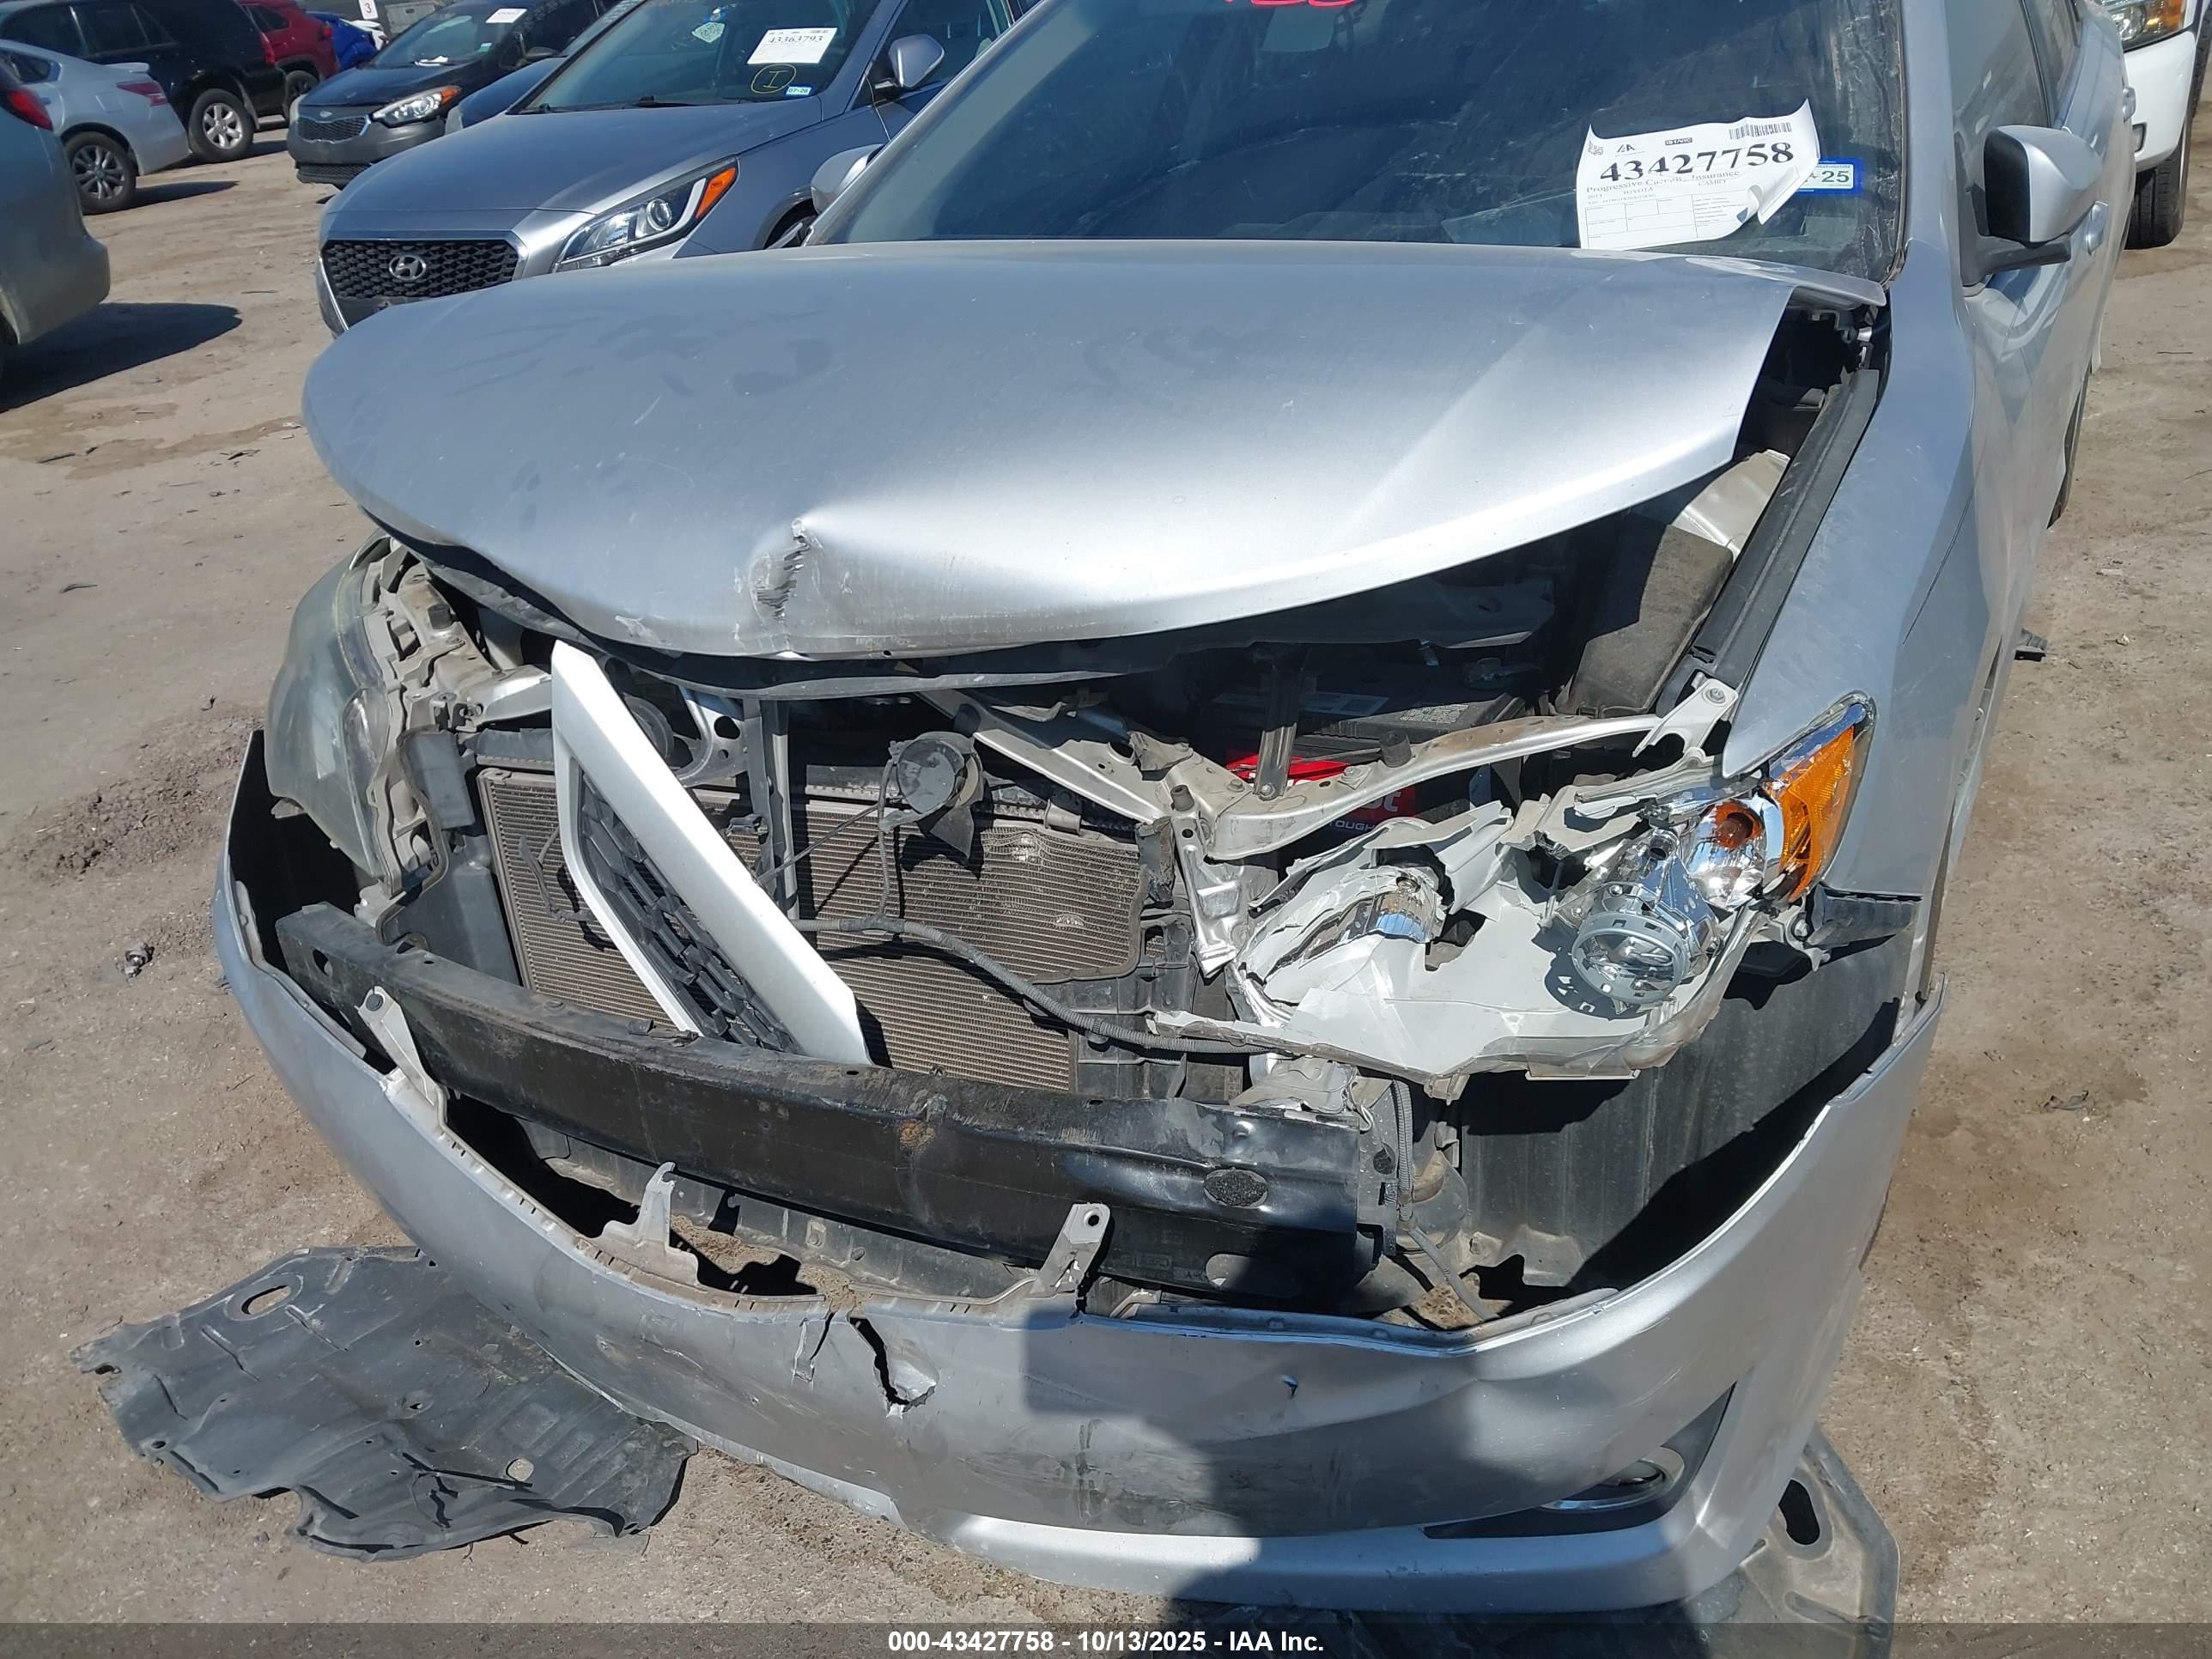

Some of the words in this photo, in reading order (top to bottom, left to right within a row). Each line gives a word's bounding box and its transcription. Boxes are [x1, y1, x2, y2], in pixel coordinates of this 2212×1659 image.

[364, 3, 372, 14] 3
[1600, 142, 1794, 182] 43427758
[1586, 181, 1643, 193] Progressive
[1692, 171, 1740, 181] Insurance
